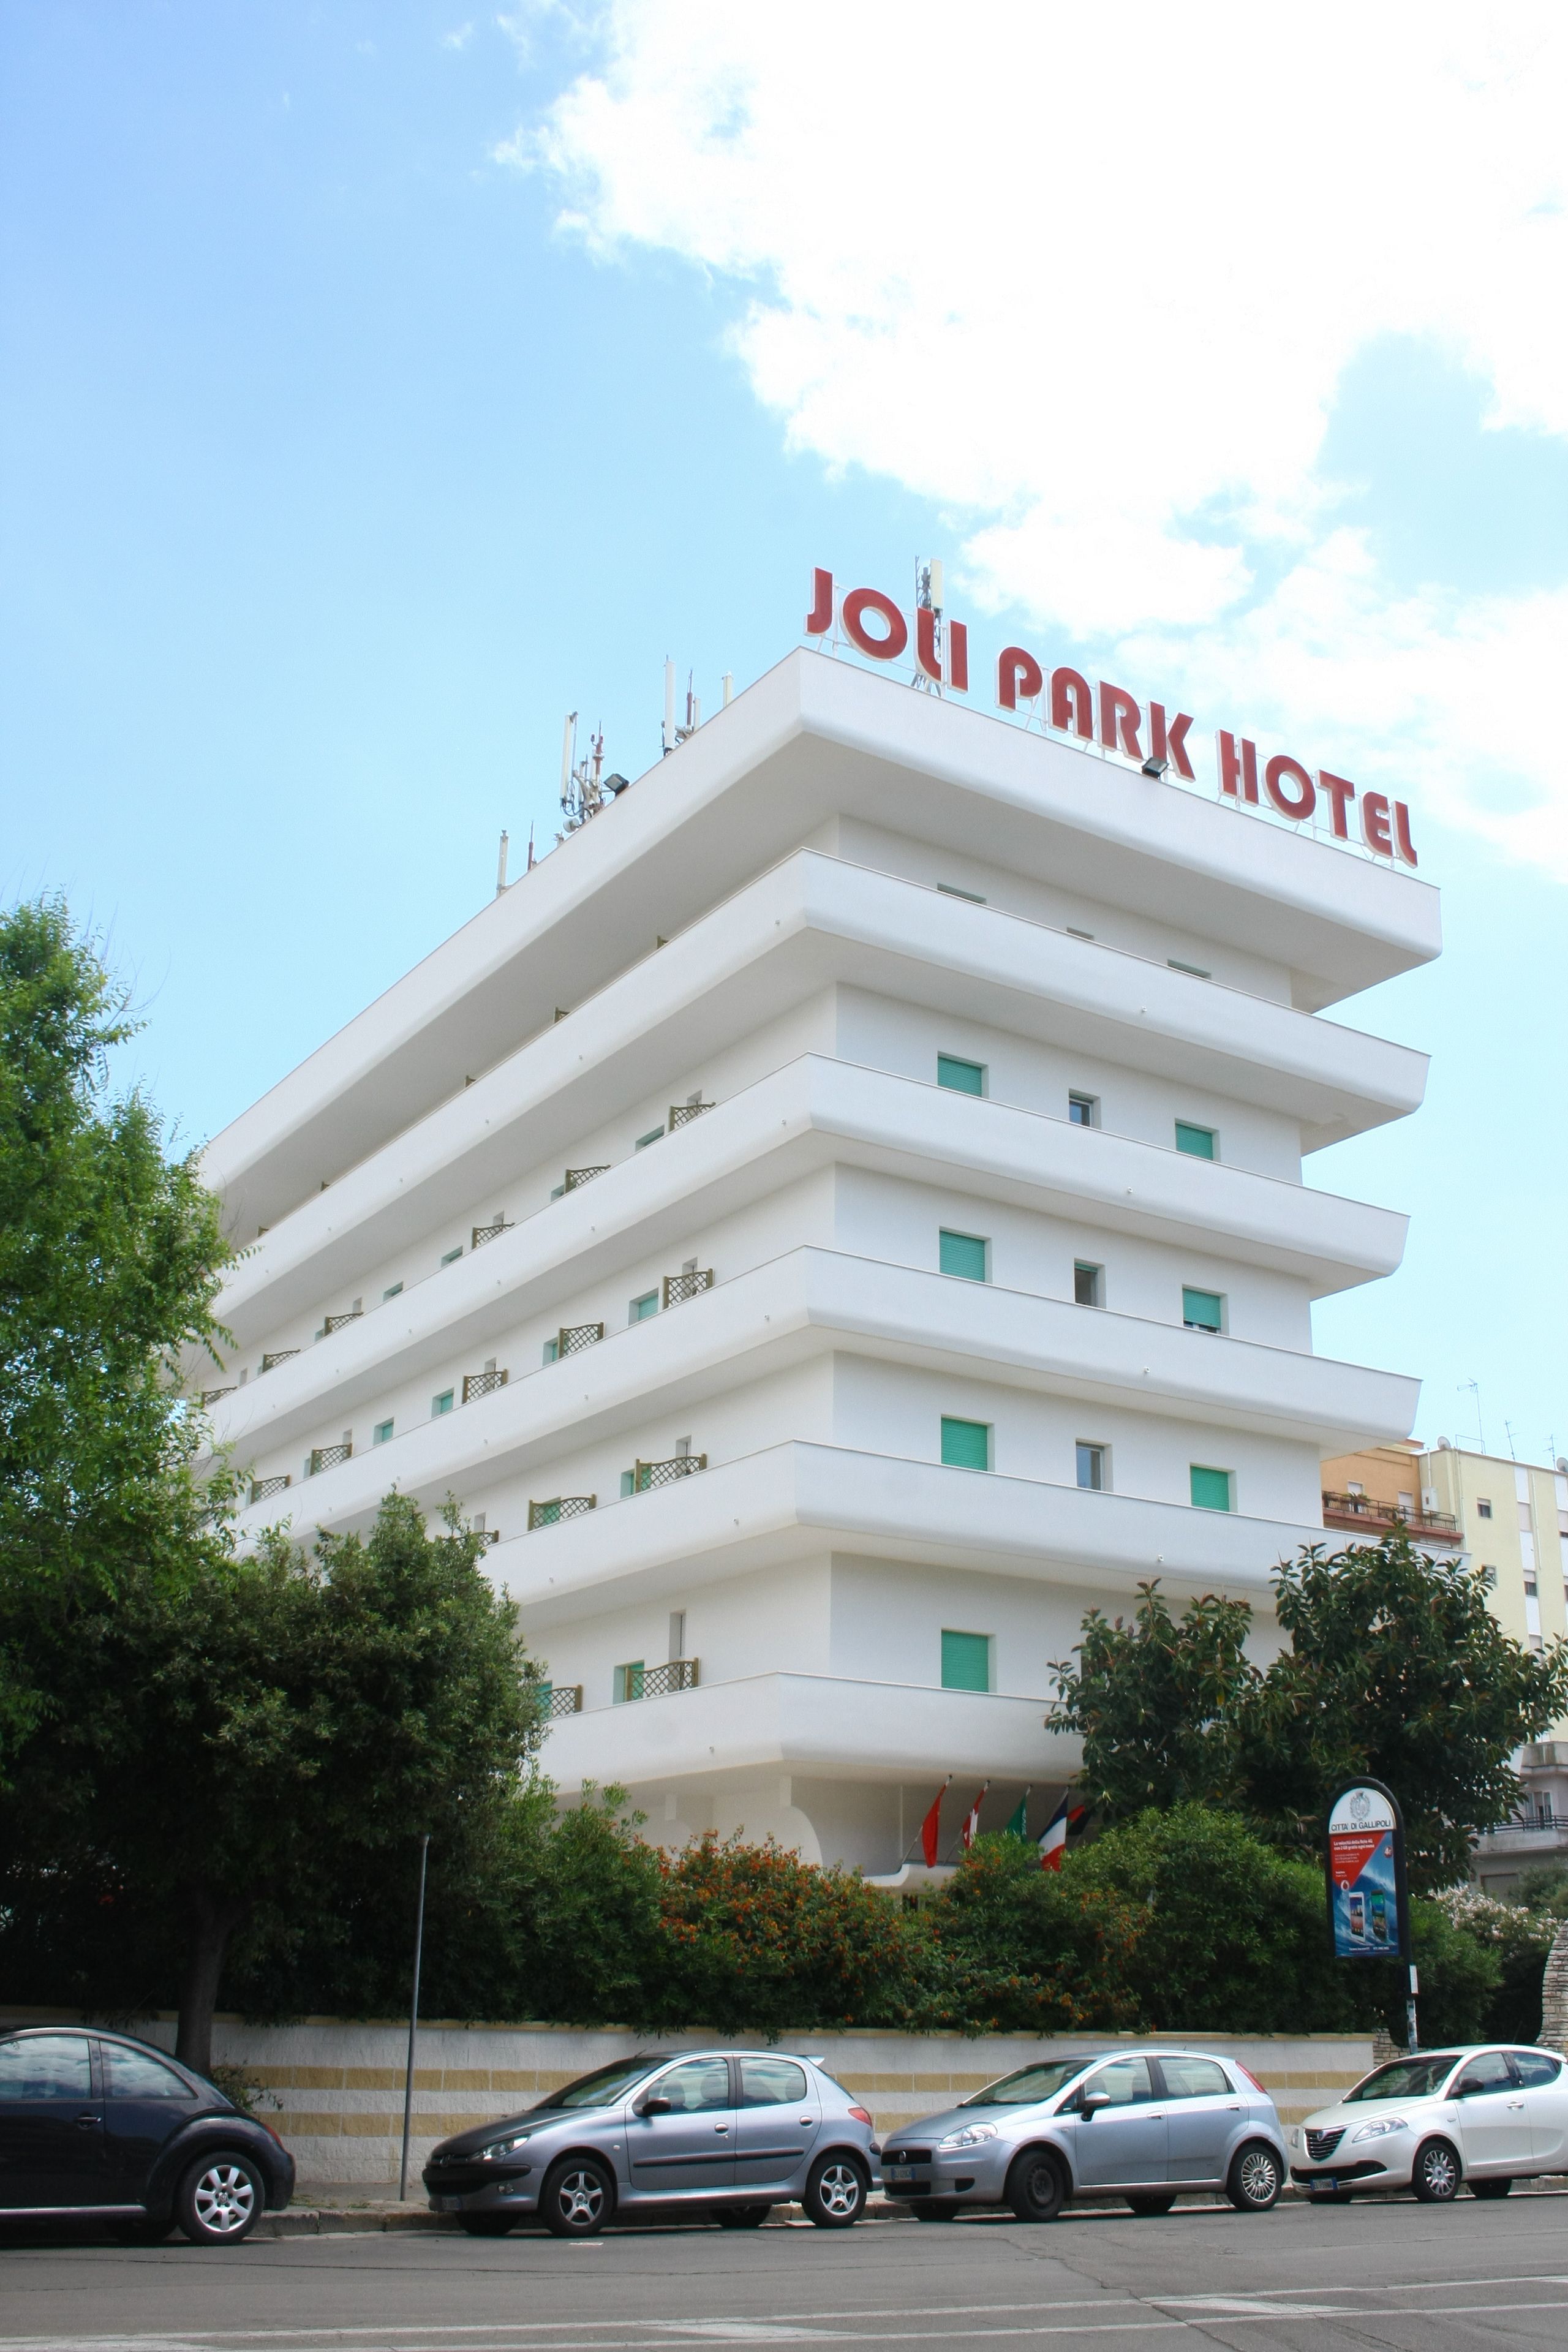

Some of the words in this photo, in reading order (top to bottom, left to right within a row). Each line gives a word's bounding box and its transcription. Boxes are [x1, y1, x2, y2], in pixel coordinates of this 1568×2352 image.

[804, 567, 968, 693] JOLI
[995, 646, 1196, 782] PARK
[1216, 729, 1417, 869] HOTEL
[1359, 1820, 1391, 1829] GALLIPOLI
